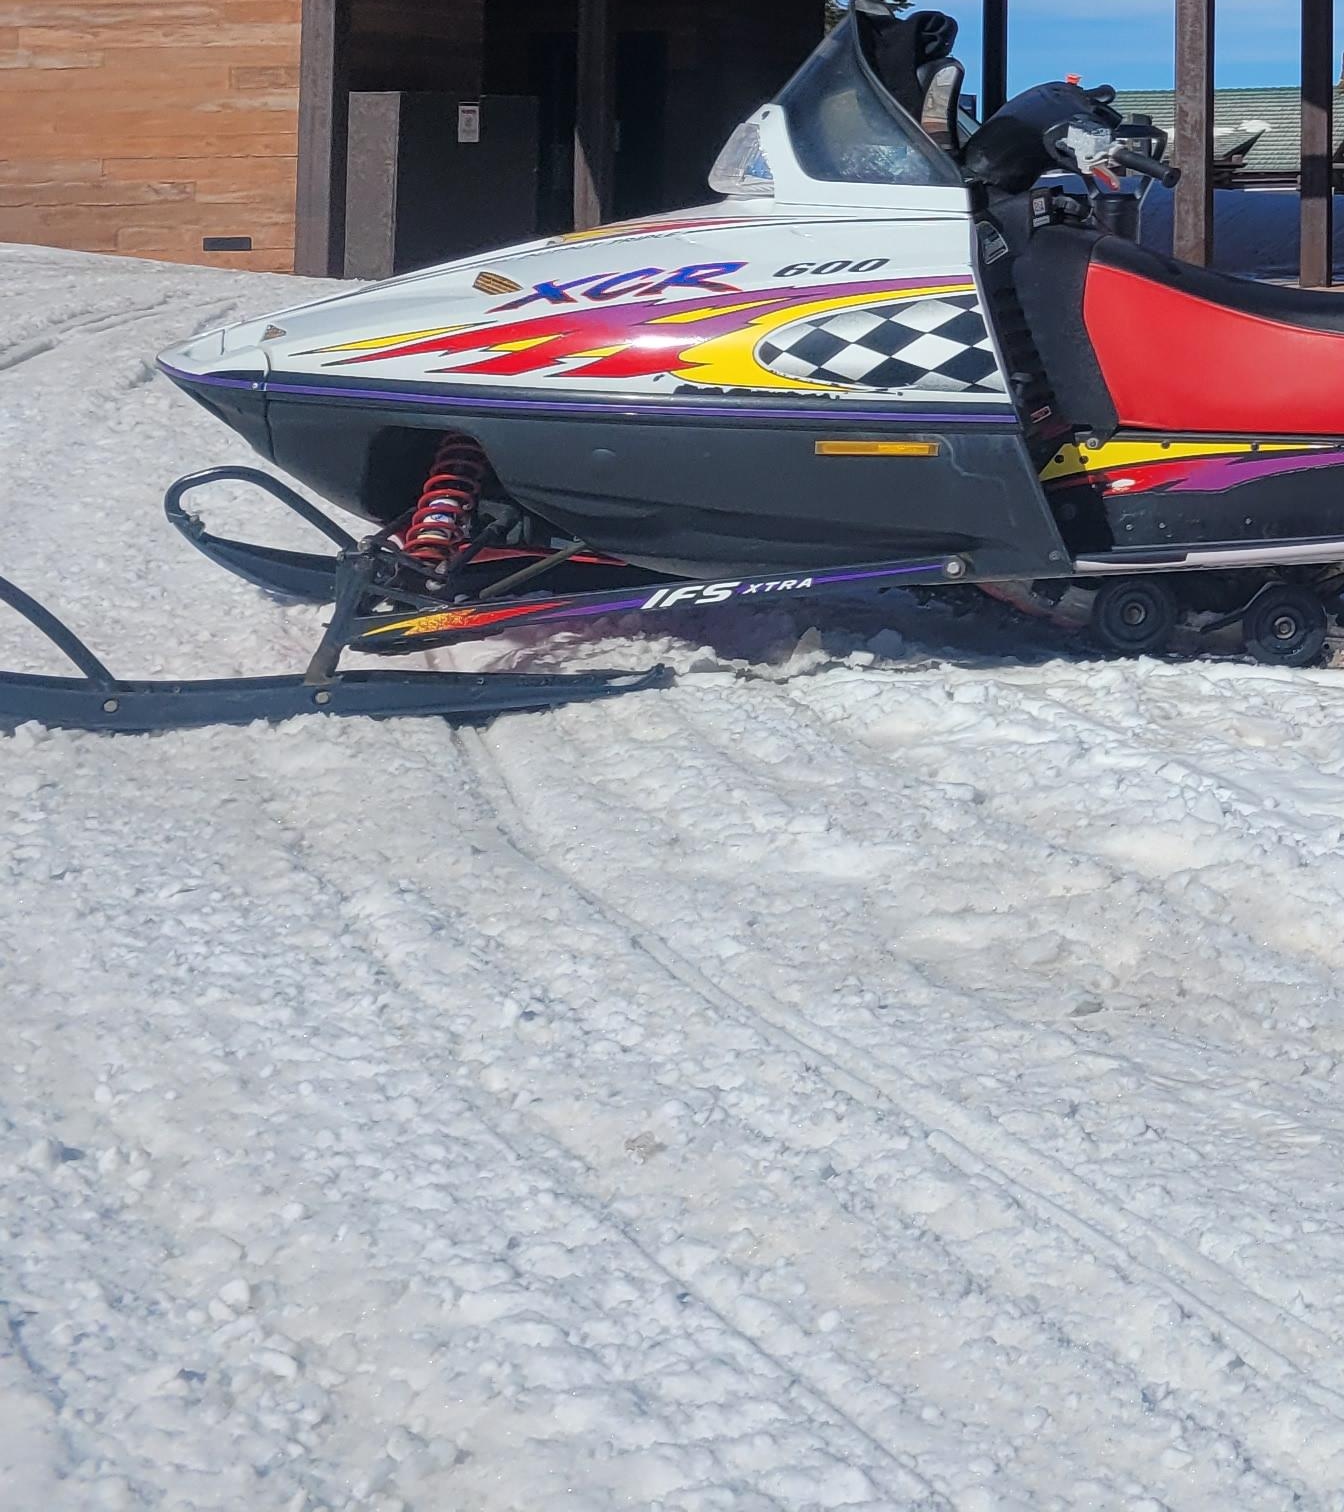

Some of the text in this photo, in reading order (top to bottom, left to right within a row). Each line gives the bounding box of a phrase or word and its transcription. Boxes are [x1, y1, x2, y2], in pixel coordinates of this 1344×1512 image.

[485, 257, 890, 314] XCR 600
[640, 577, 813, 610] IFS XTRA
